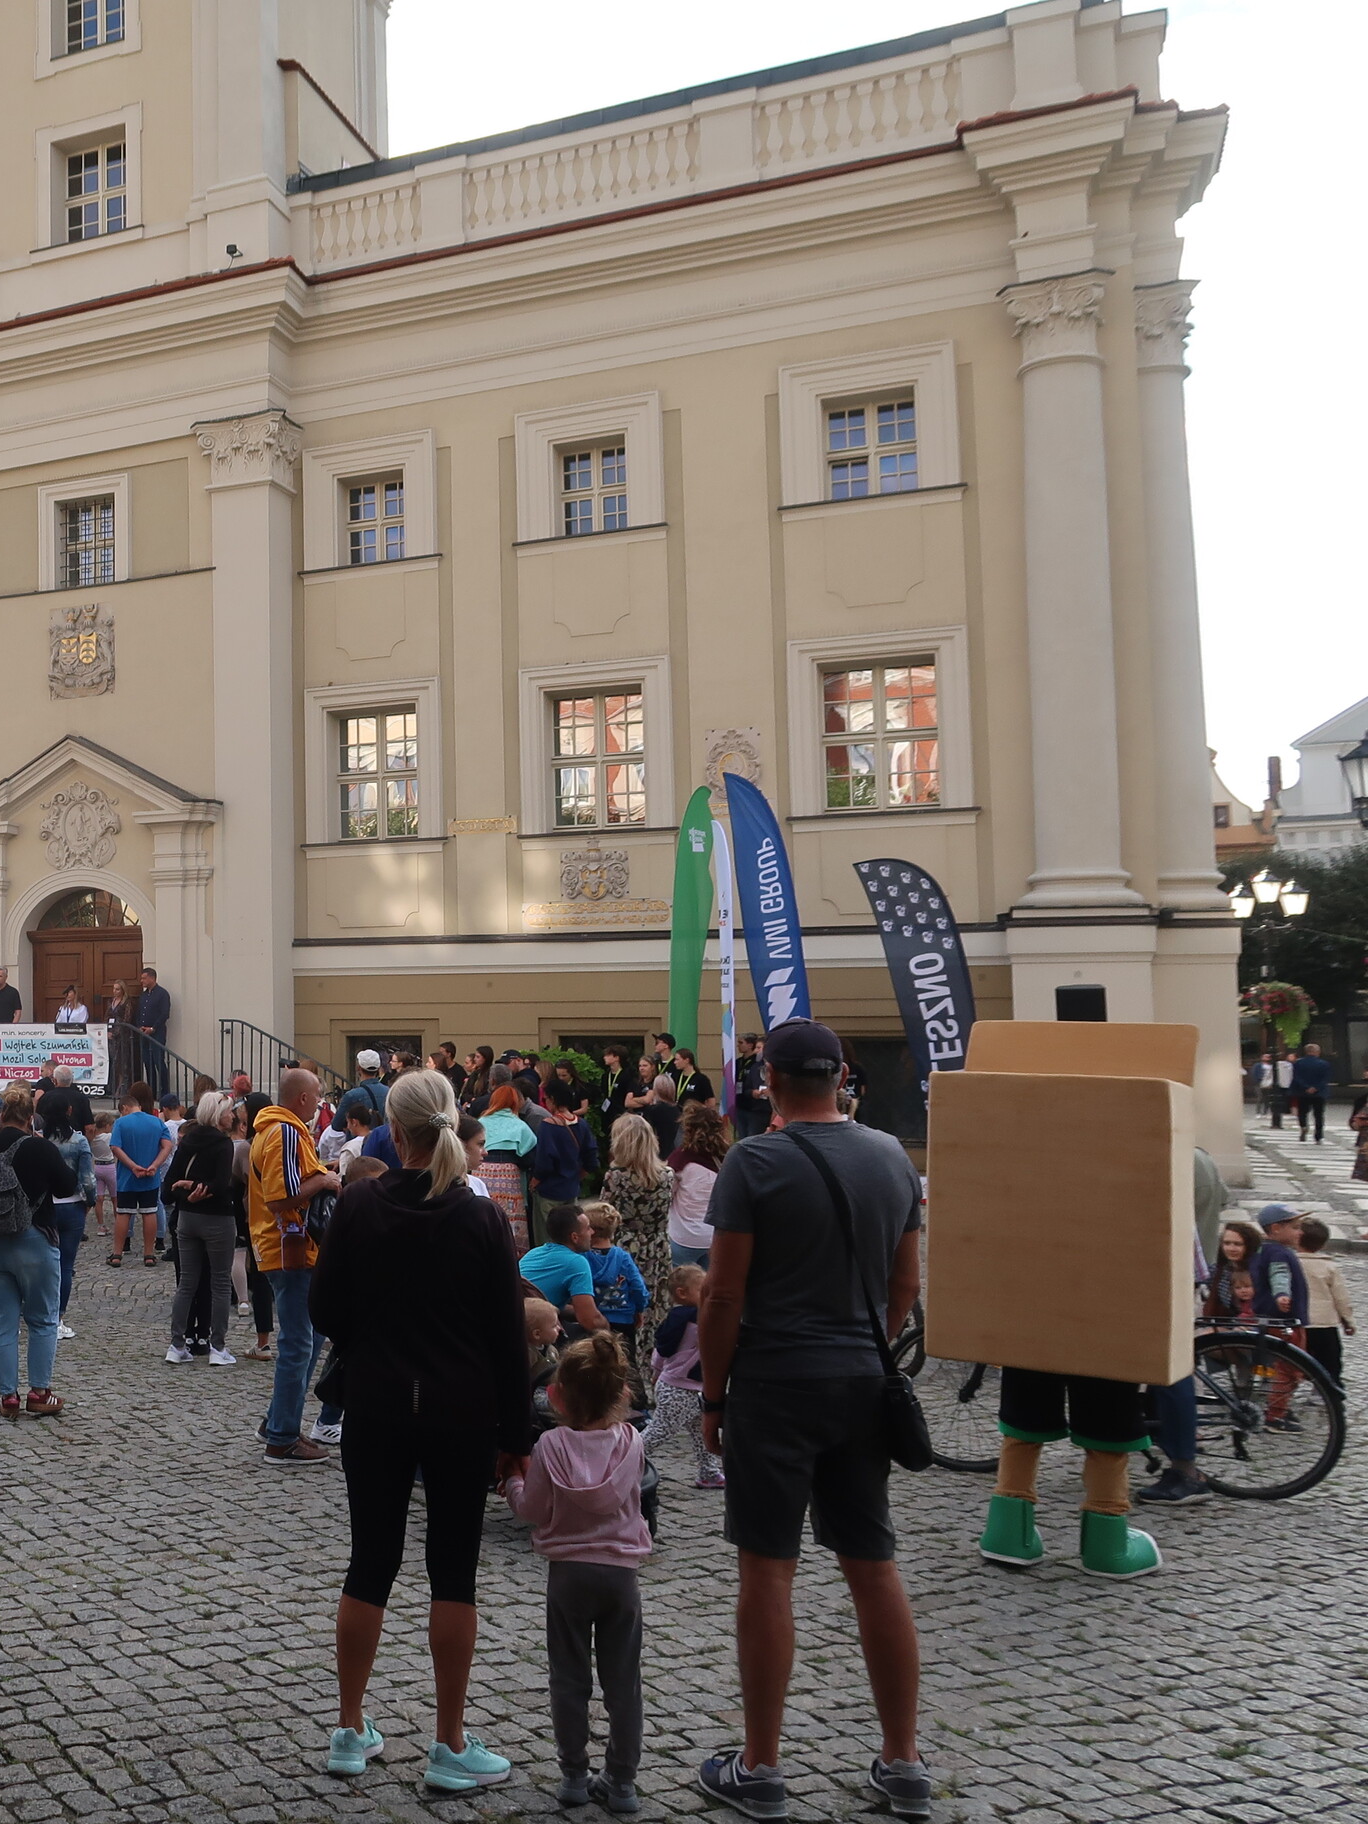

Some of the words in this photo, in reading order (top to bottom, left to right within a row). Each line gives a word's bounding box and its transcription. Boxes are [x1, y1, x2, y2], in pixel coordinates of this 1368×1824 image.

[4, 1039, 37, 1053] Wojtek
[40, 1038, 89, 1050] Szumański
[2, 1053, 24, 1064] Mozil
[27, 1053, 47, 1064] Solo
[57, 1054, 87, 1065] Wrona
[4, 1067, 34, 1078] Niczos
